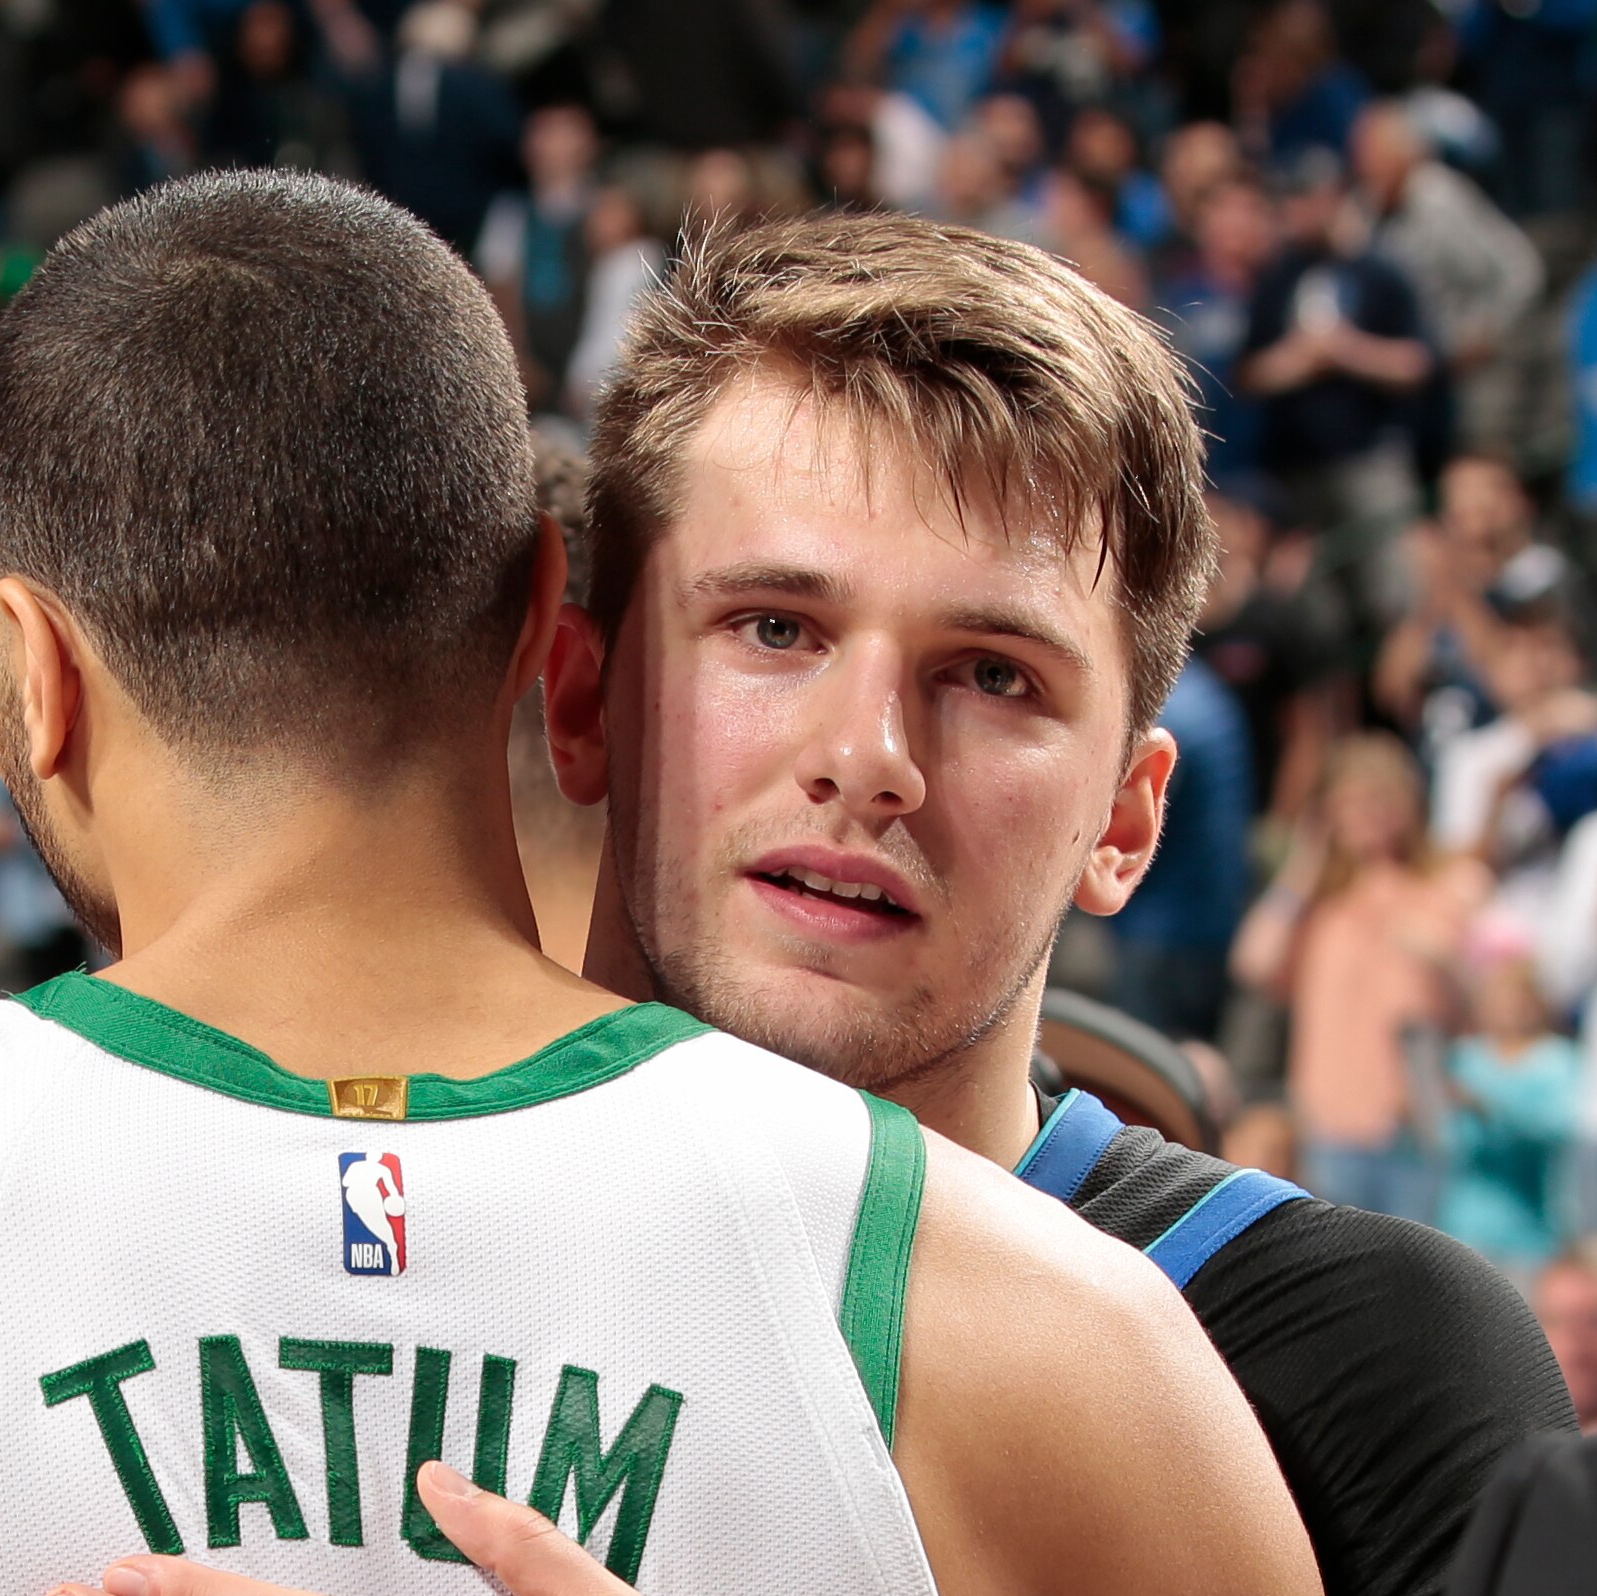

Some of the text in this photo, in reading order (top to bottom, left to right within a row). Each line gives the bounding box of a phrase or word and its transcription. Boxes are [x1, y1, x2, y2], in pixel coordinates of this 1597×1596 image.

[354, 1084, 378, 1106] 17
[351, 1243, 384, 1269] NBA
[38, 1333, 685, 1585] TATUM
